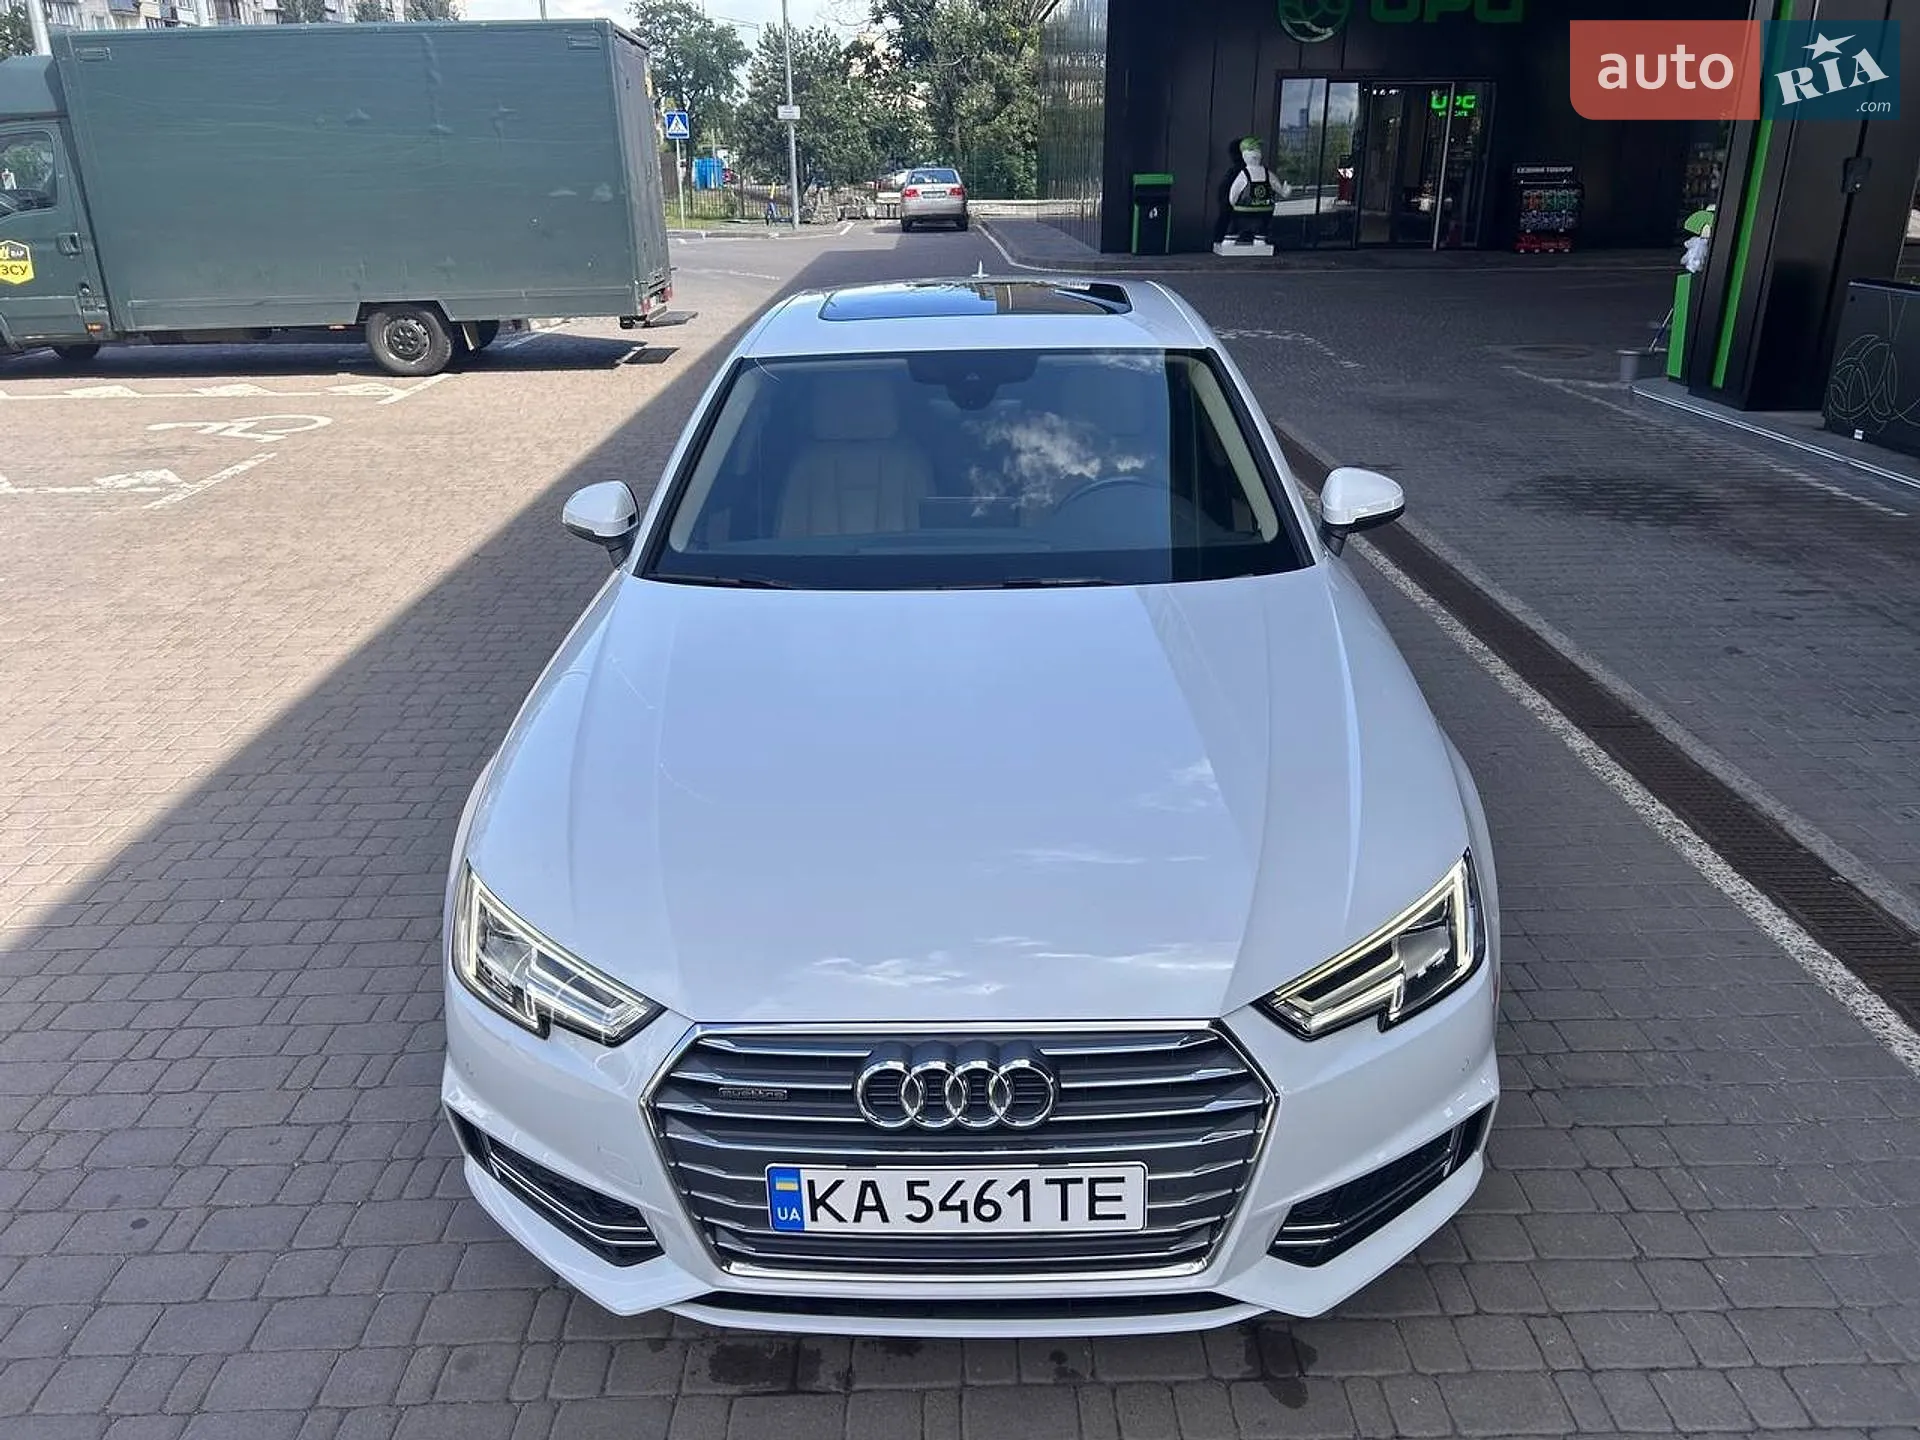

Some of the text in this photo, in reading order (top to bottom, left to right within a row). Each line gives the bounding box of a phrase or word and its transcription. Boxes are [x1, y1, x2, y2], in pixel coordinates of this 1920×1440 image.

[778, 1208, 801, 1221] UA
[805, 1175, 1127, 1224] KA 5461 TE
